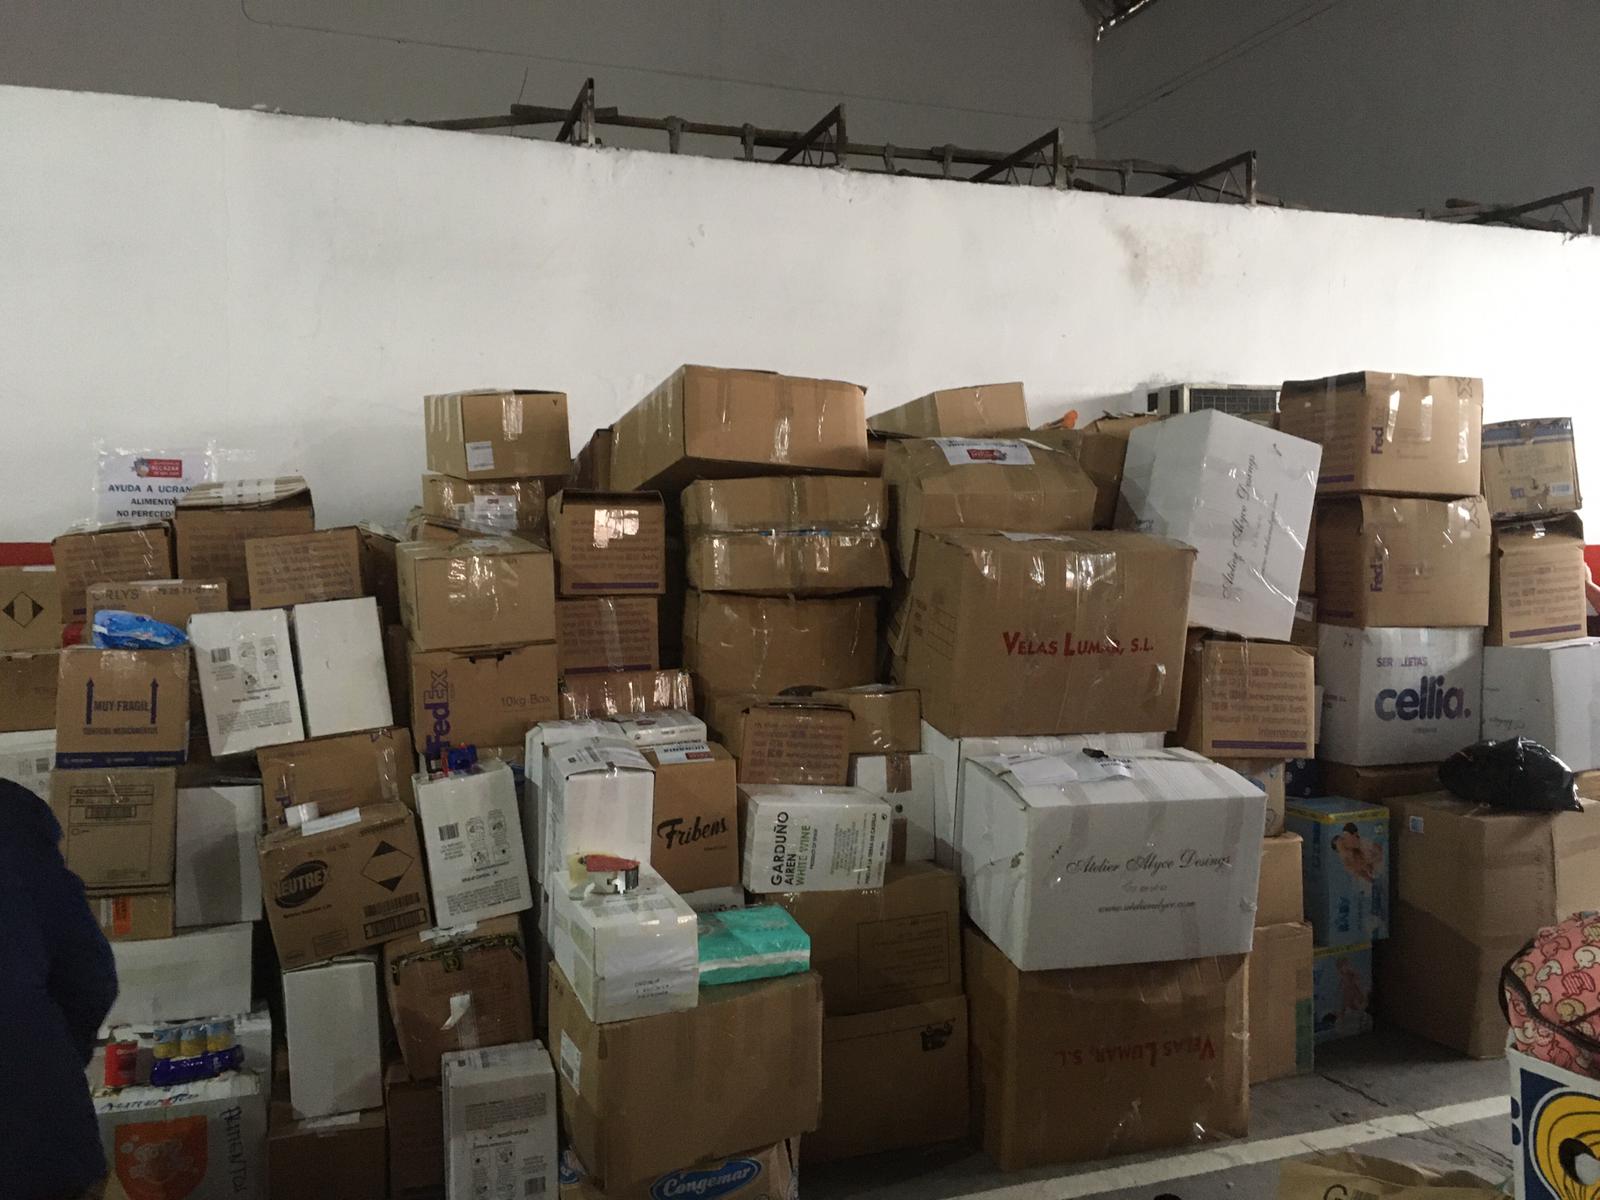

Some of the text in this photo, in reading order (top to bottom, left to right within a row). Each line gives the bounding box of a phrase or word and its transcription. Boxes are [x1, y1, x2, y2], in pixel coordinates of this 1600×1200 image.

[1371, 426, 1384, 455] Fed
[108, 484, 192, 493] AYUDA A UCRAN
[131, 498, 175, 506] ALIMENTO
[132, 510, 173, 518] PERECED
[1376, 657, 1428, 668] SERLETAS
[94, 700, 114, 712] MUY
[656, 816, 729, 849] Fribens
[770, 811, 789, 886] GARDUÑO
[795, 825, 811, 887] WHITE WINE
[784, 853, 797, 886] AIREN
[1066, 855, 1119, 874] Atelier
[1126, 852, 1174, 876] Alyce
[663, 1166, 751, 1198] Congemar
